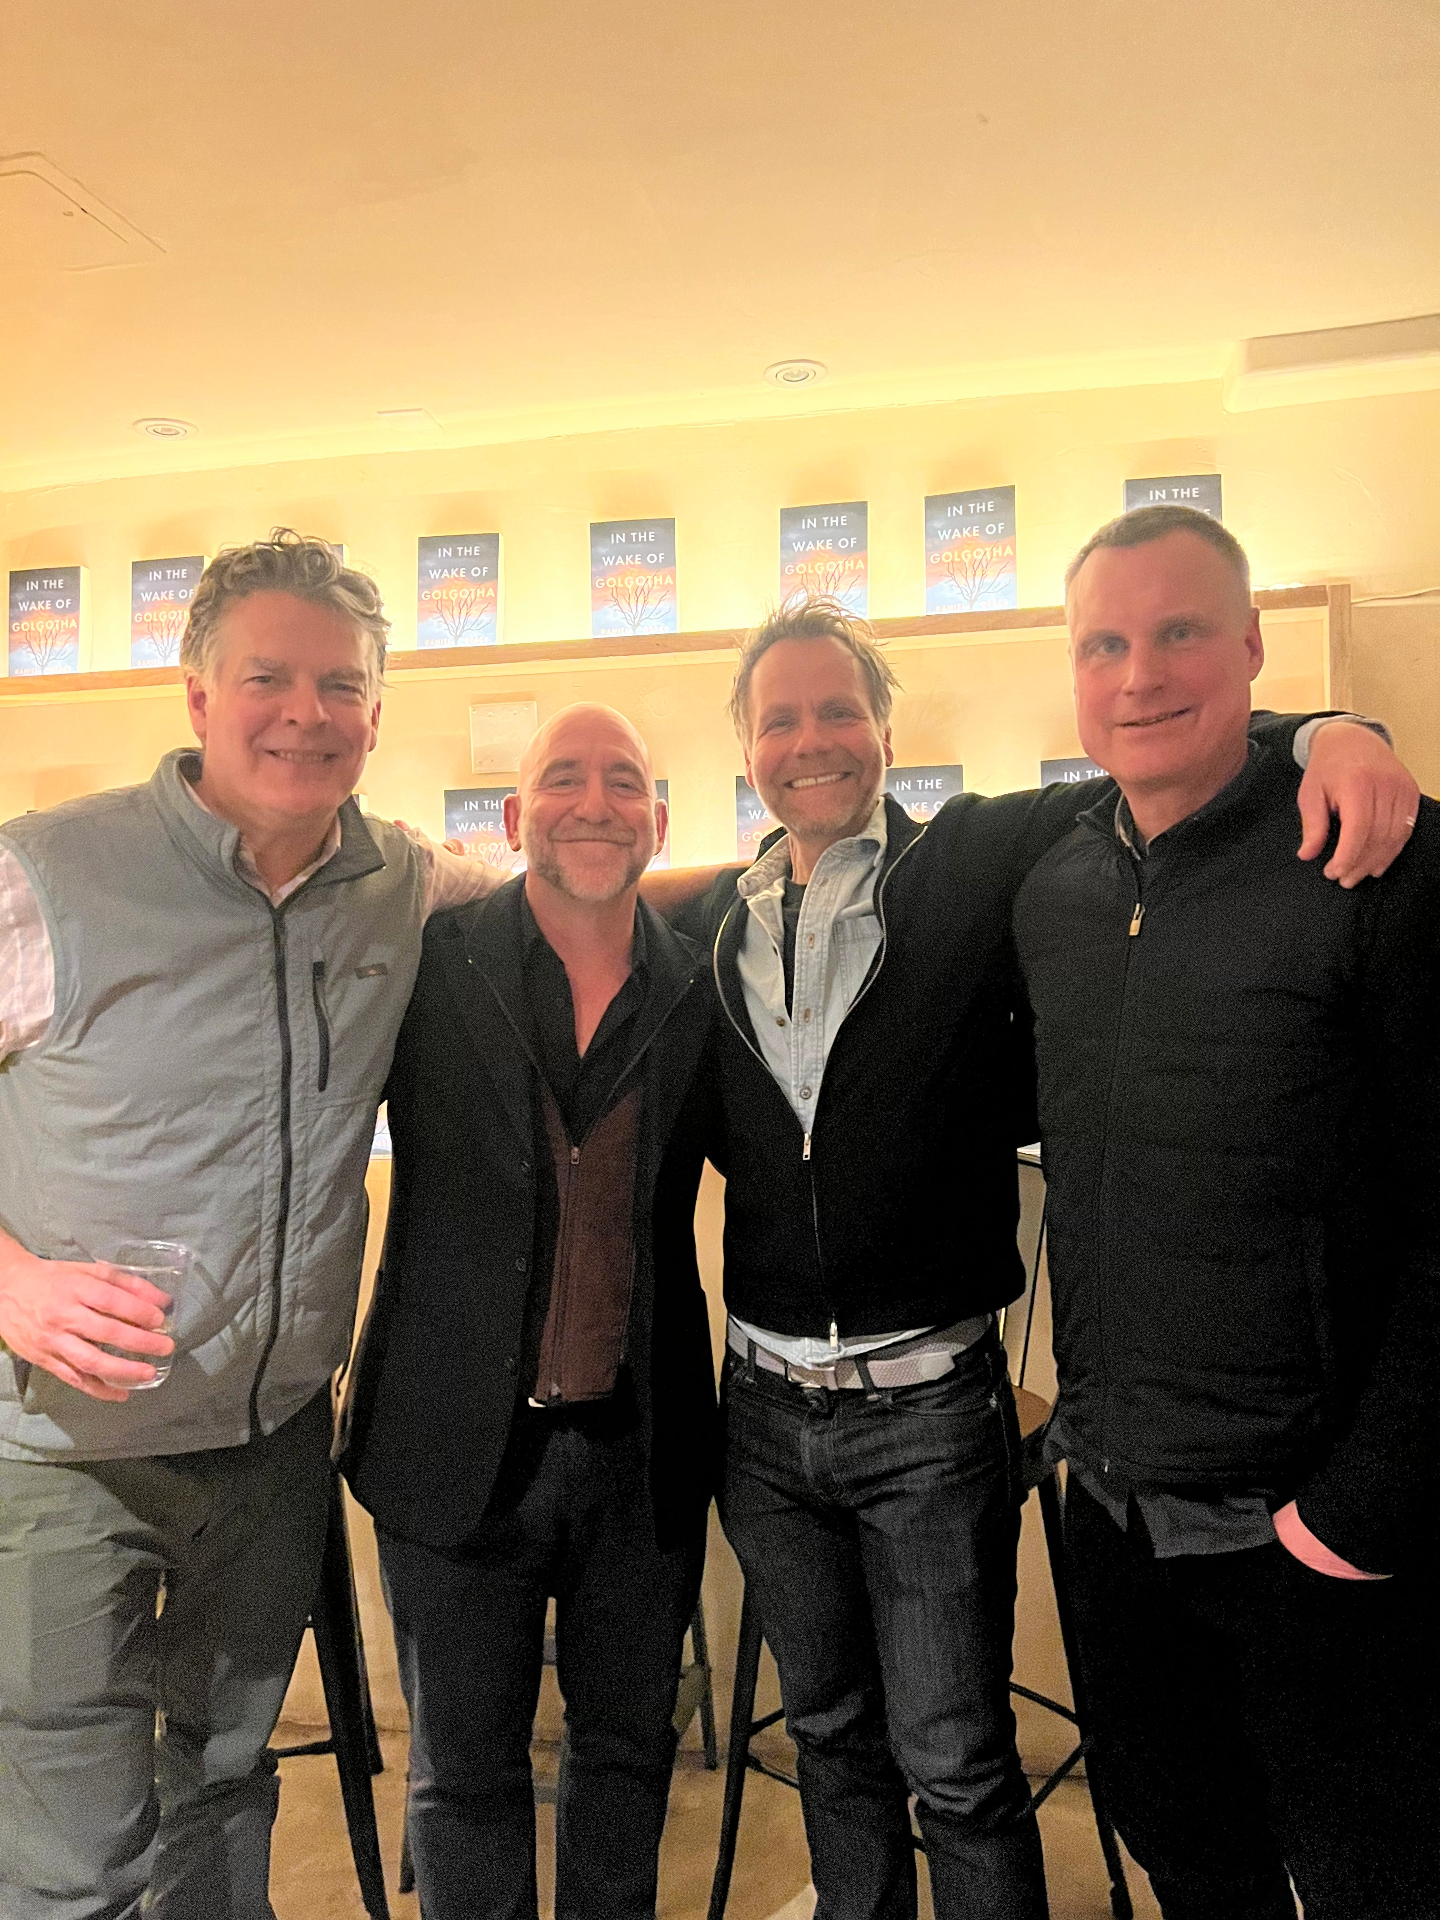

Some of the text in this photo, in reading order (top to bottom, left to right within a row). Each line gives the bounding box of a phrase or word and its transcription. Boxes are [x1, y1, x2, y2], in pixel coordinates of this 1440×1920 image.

[1149, 487, 1200, 501] IN THE
[947, 501, 995, 517] IN THE
[801, 515, 848, 530] IN THE
[611, 531, 656, 544] IN THE
[937, 522, 1005, 541] WAKE OF
[791, 537, 857, 552] WAKE OF
[438, 546, 481, 558] IN THE
[930, 545, 1014, 564] GOLGOTHA
[601, 553, 665, 567] WAKE OF
[784, 559, 865, 575] GOLGOTHA
[149, 568, 188, 582] IN THE
[428, 566, 489, 580] WAKE OF
[26, 579, 64, 591] IN THE
[595, 574, 674, 589] GOLGOTHA
[140, 588, 195, 602] WAKE OF
[421, 587, 495, 601] GOLGOTHA
[18, 598, 72, 612] WAKE OF
[134, 609, 191, 623] GOLGOTH
[12, 618, 78, 633] GOLGOTHA
[1064, 769, 1110, 783] IN TH
[895, 778, 943, 791] IN THE
[464, 800, 479, 811] IN
[902, 800, 945, 813] AKE O
[748, 809, 771, 820] WA
[455, 821, 494, 833] WAKE
